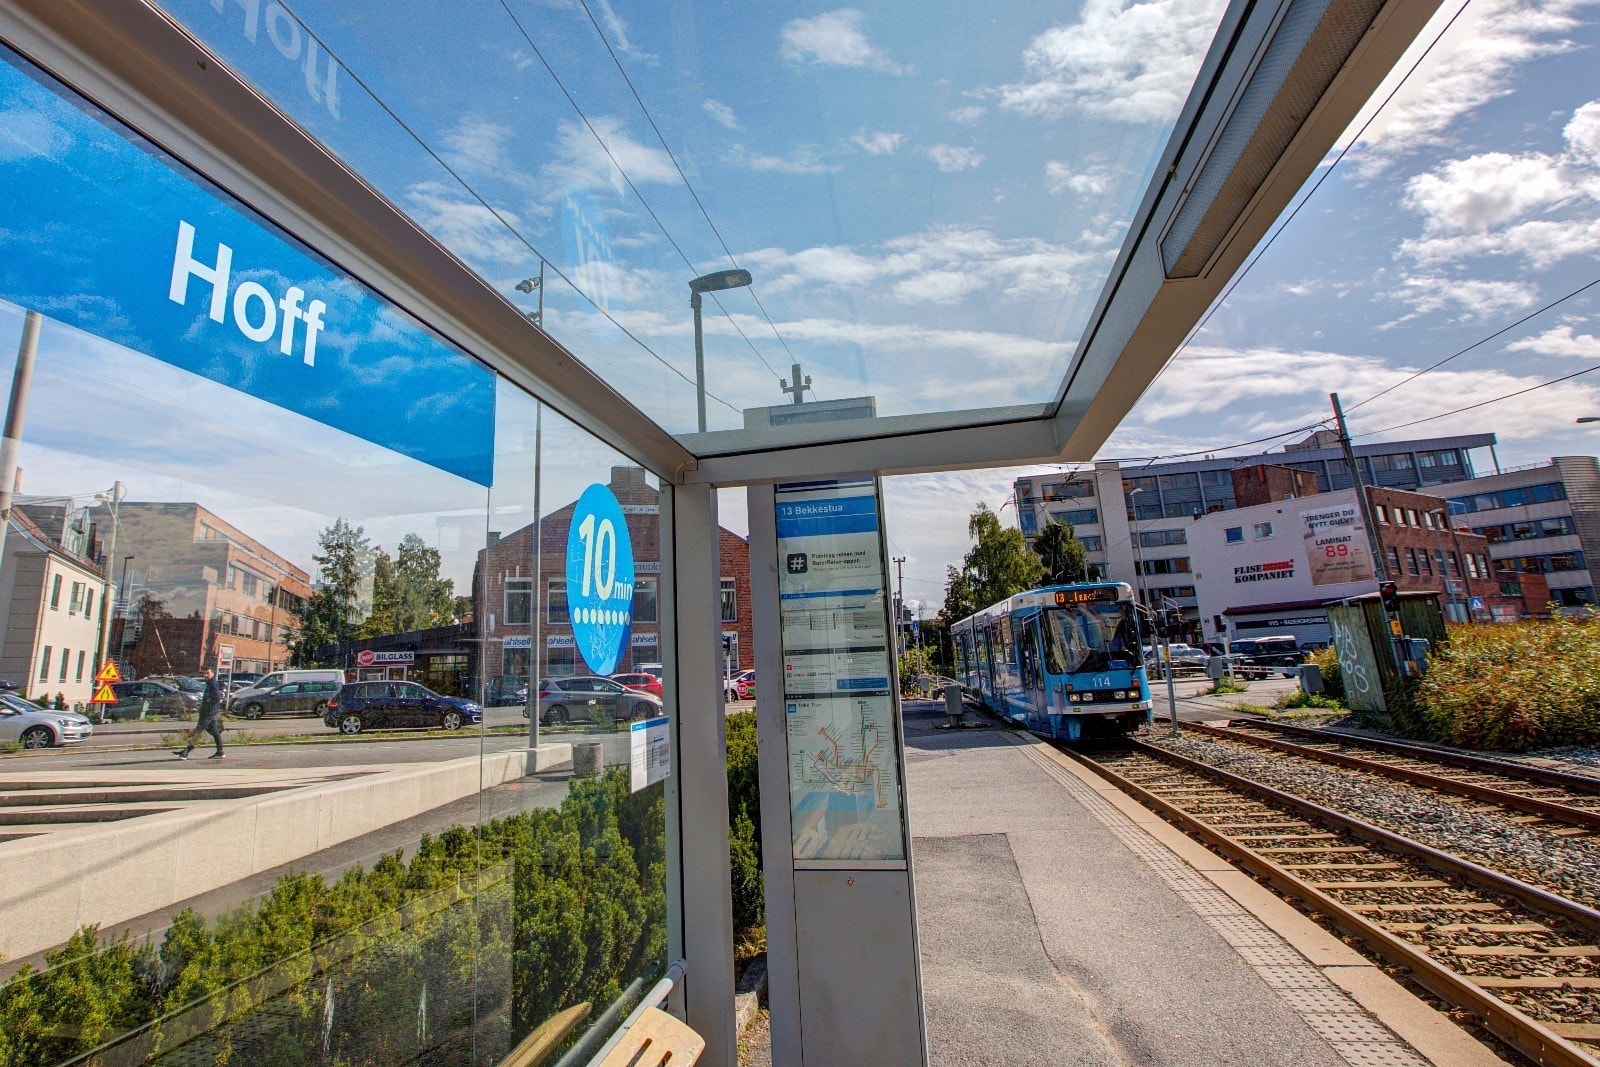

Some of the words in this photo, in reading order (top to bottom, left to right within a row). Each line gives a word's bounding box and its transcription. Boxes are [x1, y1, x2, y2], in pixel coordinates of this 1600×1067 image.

[169, 219, 327, 367] Hoff
[781, 507, 793, 516] 13
[795, 504, 844, 515] Bekkestua
[1305, 511, 1341, 522] TRENGER
[1308, 521, 1328, 529] NYTT
[1329, 517, 1354, 526] GULV?
[1315, 535, 1352, 546] LAMINAT
[1325, 544, 1360, 558] 89,-
[578, 513, 616, 600] 10
[614, 576, 633, 601] min
[1234, 564, 1262, 575] FLISE
[1234, 569, 1295, 584] KOMPANIET
[503, 637, 531, 646] ahlsell
[547, 636, 574, 645] ahlsell
[631, 635, 658, 644] ahlsell
[376, 653, 413, 661] BILGLASS
[1092, 676, 1111, 688] 114
